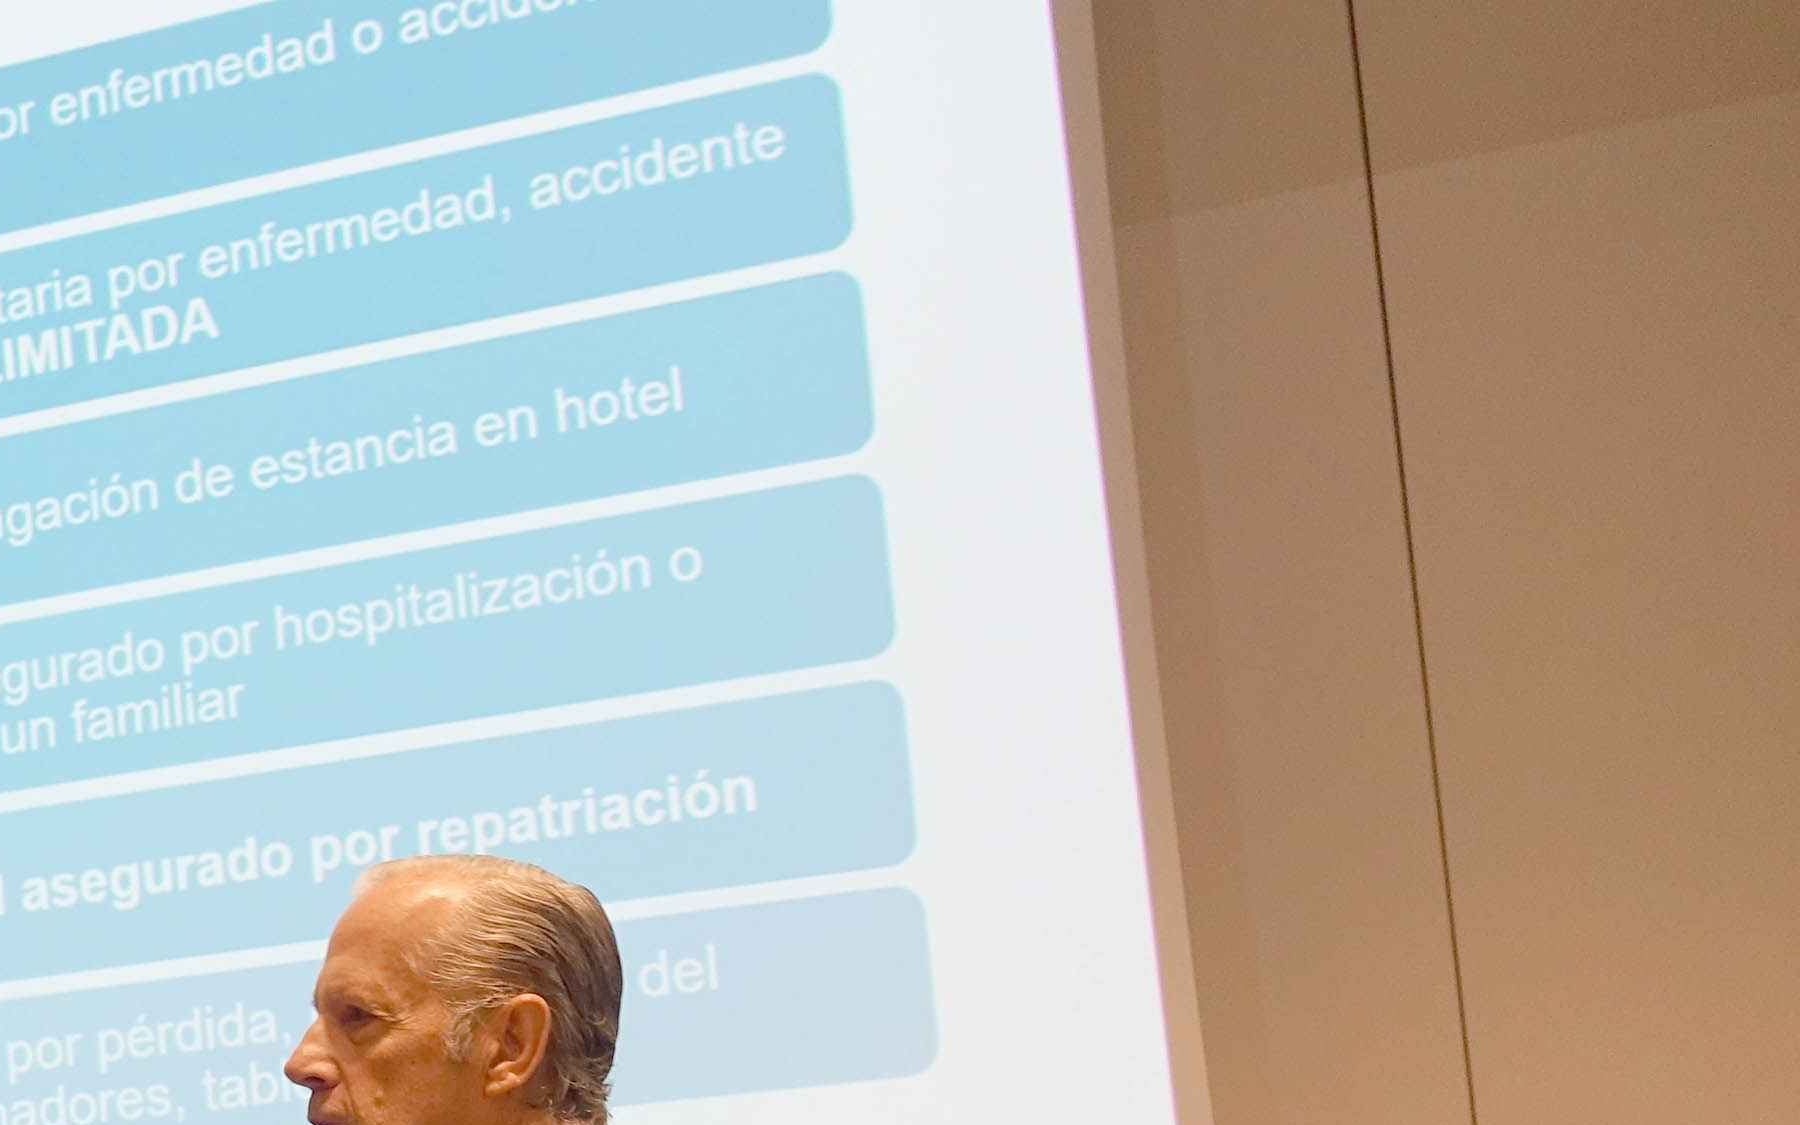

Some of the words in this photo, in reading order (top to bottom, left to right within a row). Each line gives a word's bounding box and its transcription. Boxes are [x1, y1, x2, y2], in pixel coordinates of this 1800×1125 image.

[49, 19, 335, 126] enfermedad
[352, 20, 382, 55] o
[108, 249, 184, 312] por
[200, 175, 512, 279] enfermedad,
[529, 120, 787, 211] accidente
[174, 458, 235, 504] de
[249, 415, 459, 490] estancia
[474, 404, 540, 448] en
[554, 365, 685, 433] hotel
[180, 621, 259, 676] por
[274, 548, 652, 650] hospitalización
[670, 546, 703, 581] o
[0, 716, 57, 755] un
[70, 679, 246, 744] familiar
[22, 836, 294, 911] asegurado
[310, 825, 400, 883] por
[417, 770, 758, 855] repatriación
[7, 1033, 82, 1084] por
[97, 1000, 292, 1072] pérdida,
[638, 943, 719, 999] del
